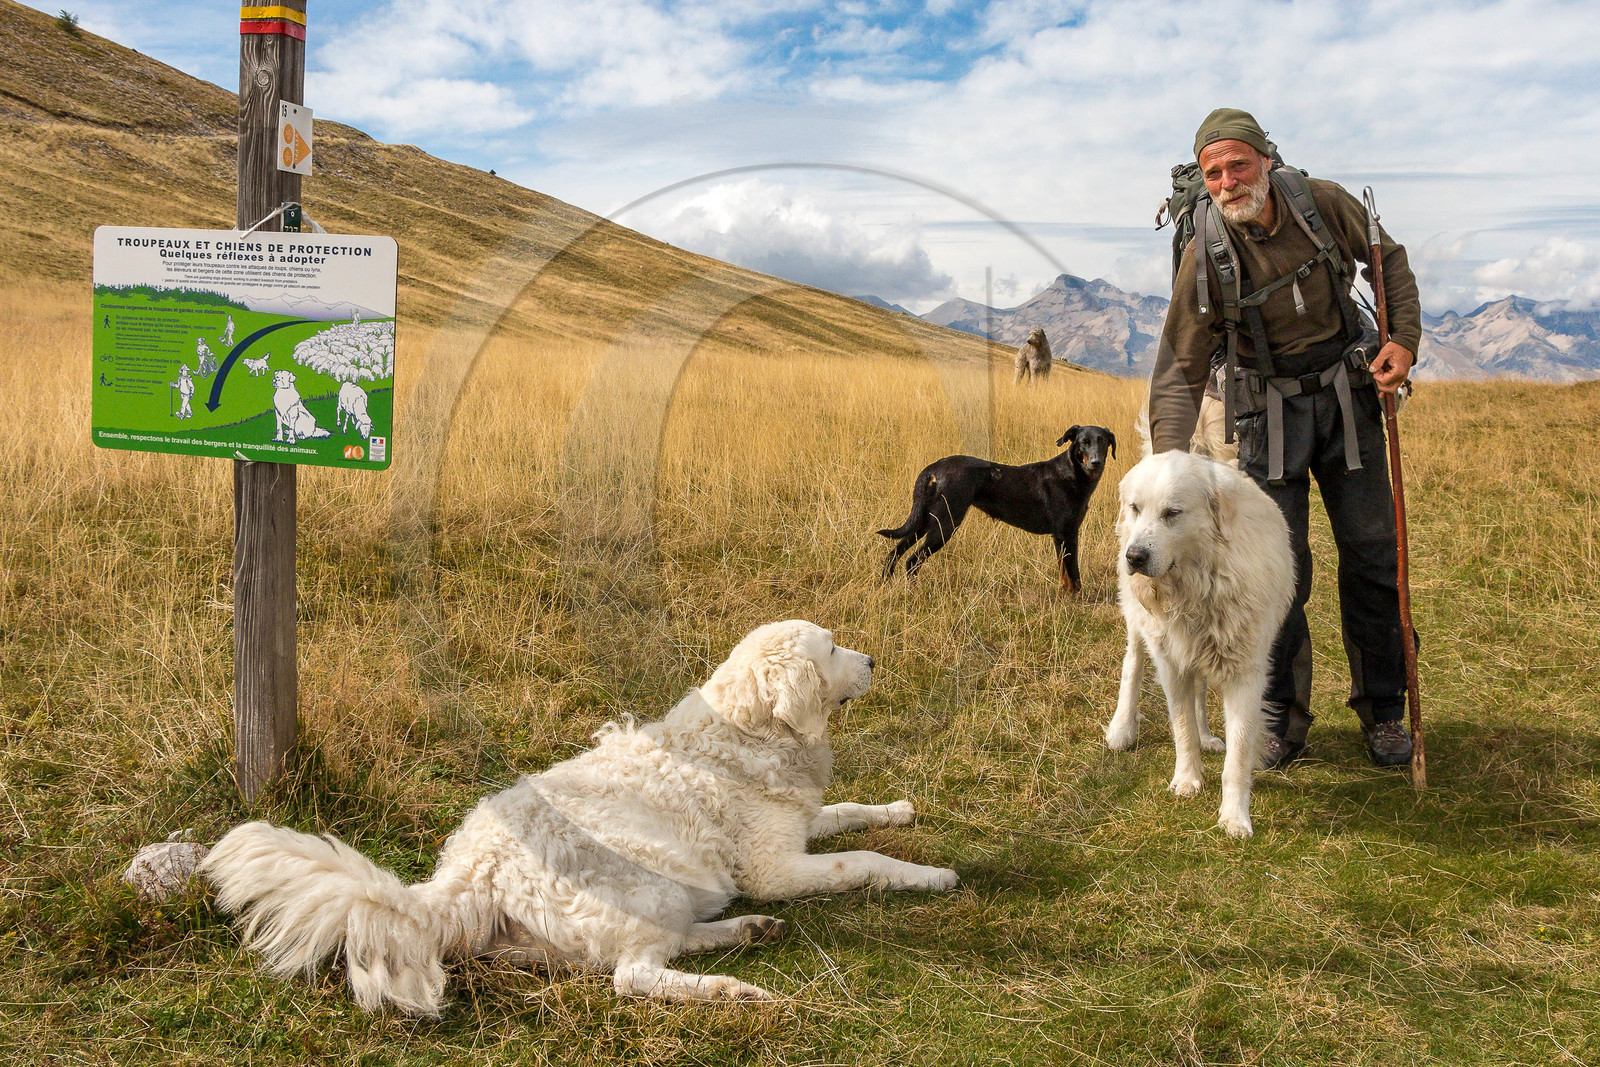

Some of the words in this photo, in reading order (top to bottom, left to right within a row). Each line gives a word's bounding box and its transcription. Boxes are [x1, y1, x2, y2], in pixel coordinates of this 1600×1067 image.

[117, 238, 190, 249] TROUPEAUX
[196, 241, 210, 250] ET
[216, 242, 262, 252] CHIENS
[268, 244, 283, 252] DE
[290, 245, 371, 256] PROTECTION
[160, 249, 212, 260] Quelques
[217, 251, 264, 261] réflexes
[269, 254, 274, 262] à
[280, 254, 325, 265] adopter
[99, 431, 129, 440] Ensemble,
[204, 439, 227, 447] bergers
[243, 442, 276, 450] tranquillité
